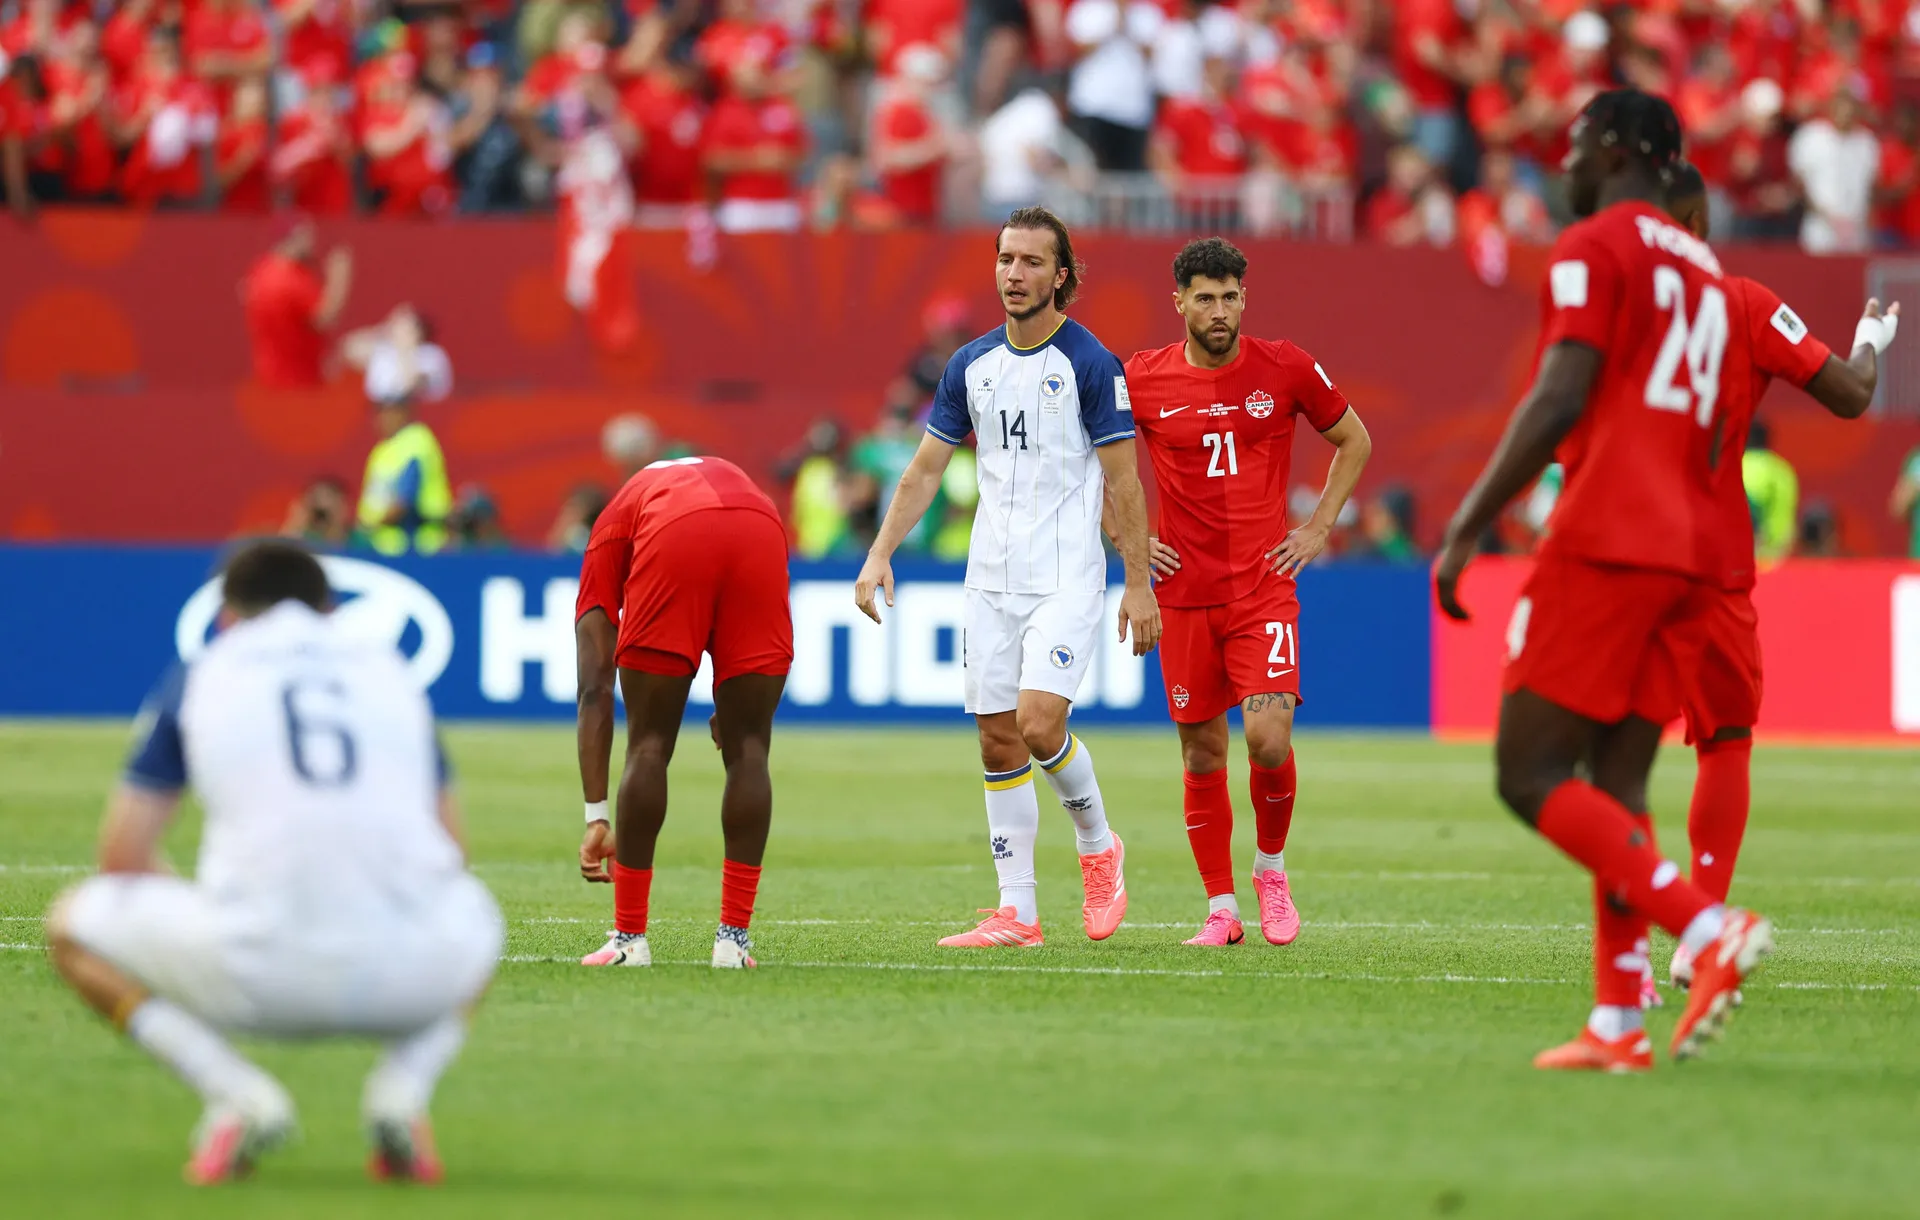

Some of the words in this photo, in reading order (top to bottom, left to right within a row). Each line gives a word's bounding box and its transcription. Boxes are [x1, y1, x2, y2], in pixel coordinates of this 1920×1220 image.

[1644, 265, 1730, 428] 24
[1000, 410, 1027, 450] 14
[1203, 431, 1238, 477] 21
[1265, 621, 1295, 666] 21
[281, 679, 357, 789] 6
[993, 851, 1014, 860] KELME
